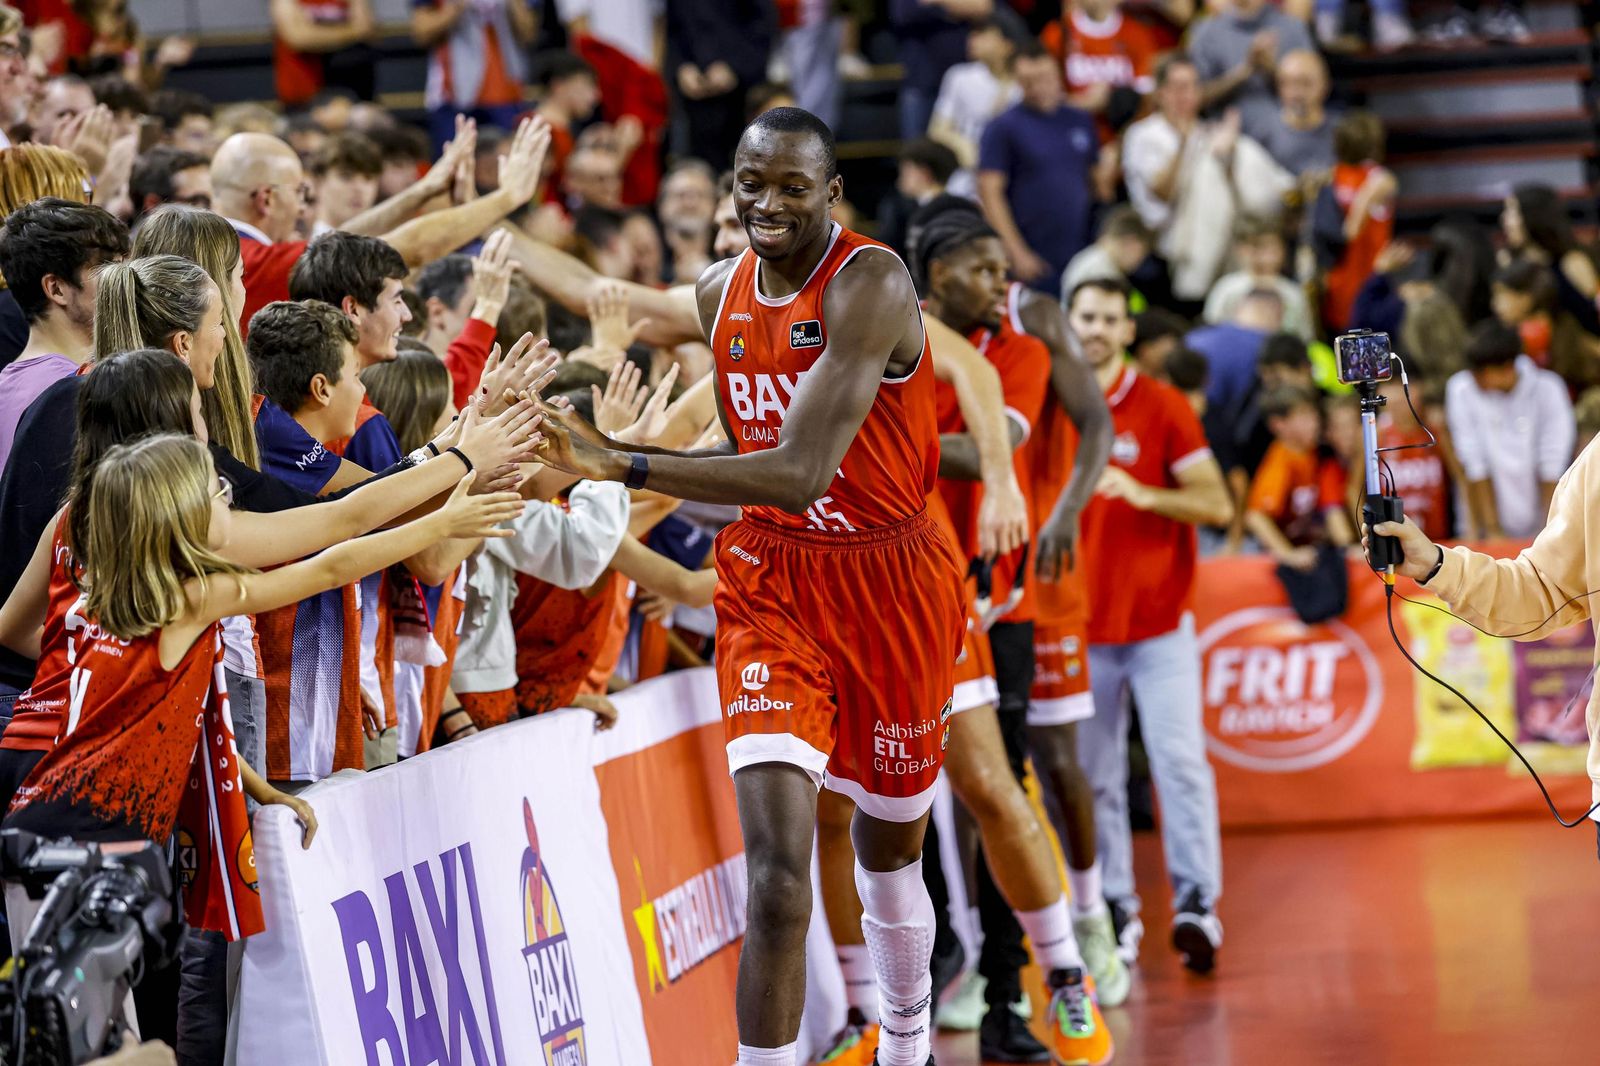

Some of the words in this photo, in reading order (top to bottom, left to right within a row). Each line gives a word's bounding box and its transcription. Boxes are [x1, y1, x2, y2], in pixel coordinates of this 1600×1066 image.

[793, 336, 820, 345] endesa
[726, 370, 812, 422] BAX
[1206, 641, 1349, 707] FRIT
[727, 694, 794, 718] unilabor
[874, 719, 936, 739] Adbisio
[874, 735, 912, 759] ETL
[874, 754, 937, 775] GLOBAL
[330, 841, 506, 1066] BAXI
[526, 939, 581, 1037] BAXI
